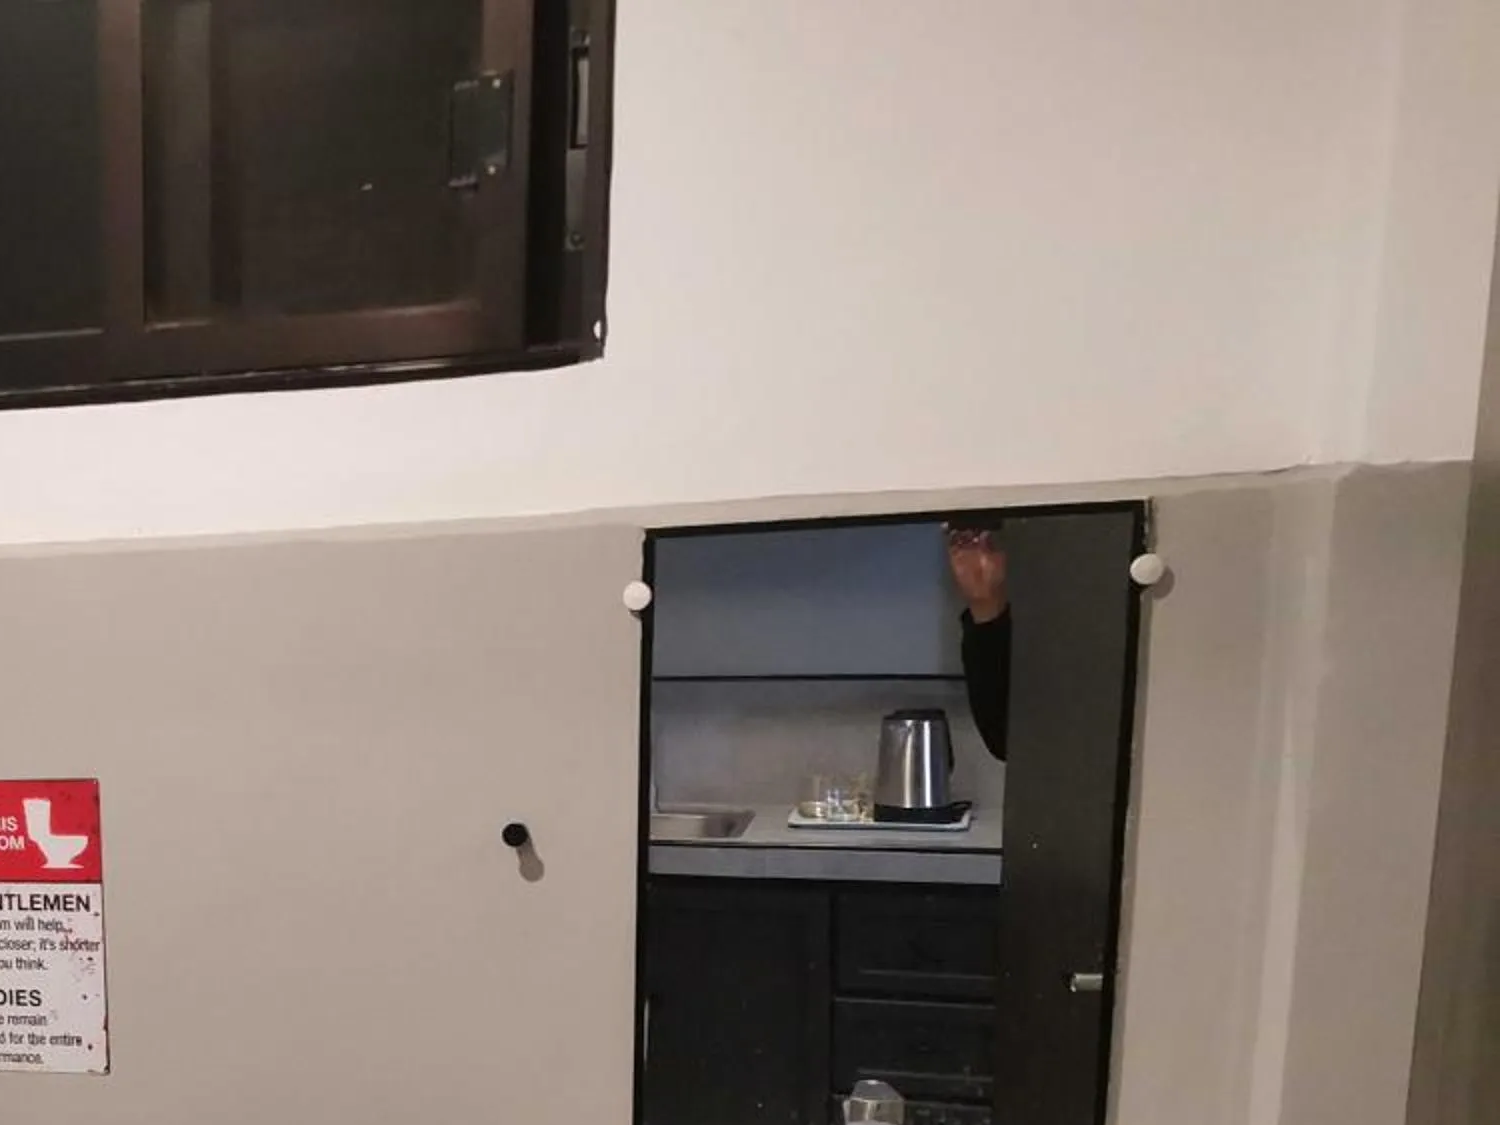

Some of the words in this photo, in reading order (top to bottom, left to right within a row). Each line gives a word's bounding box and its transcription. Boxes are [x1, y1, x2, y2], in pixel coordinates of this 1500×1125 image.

[13, 916, 35, 930] will
[38, 939, 57, 951] it's
[59, 938, 101, 952] shorter
[7, 1012, 48, 1026] remain
[9, 1032, 25, 1045] for
[27, 1032, 47, 1046] the
[49, 1034, 83, 1047] entire
